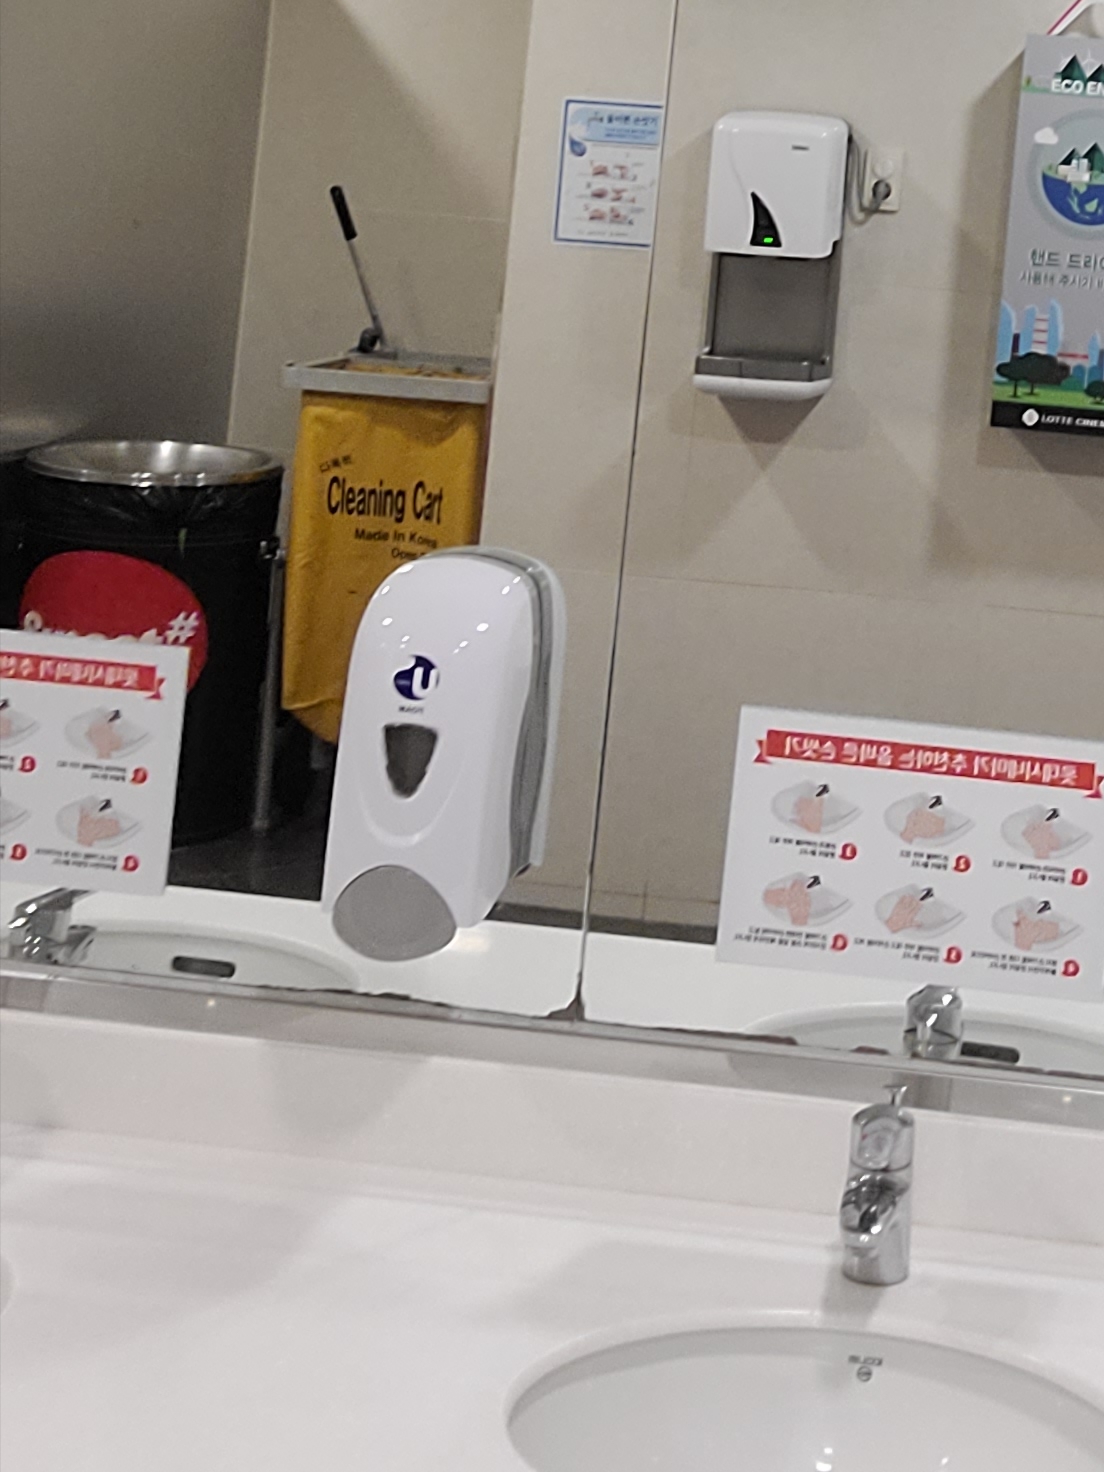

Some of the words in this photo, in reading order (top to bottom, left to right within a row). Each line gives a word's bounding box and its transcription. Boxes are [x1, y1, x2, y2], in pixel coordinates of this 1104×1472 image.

[1051, 78, 1085, 95] ECO
[1030, 248, 1061, 267] 핸드
[1041, 413, 1073, 425] LOTTE
[327, 475, 406, 524] Cleaning
[412, 480, 443, 525] Cart
[355, 528, 390, 542] Made
